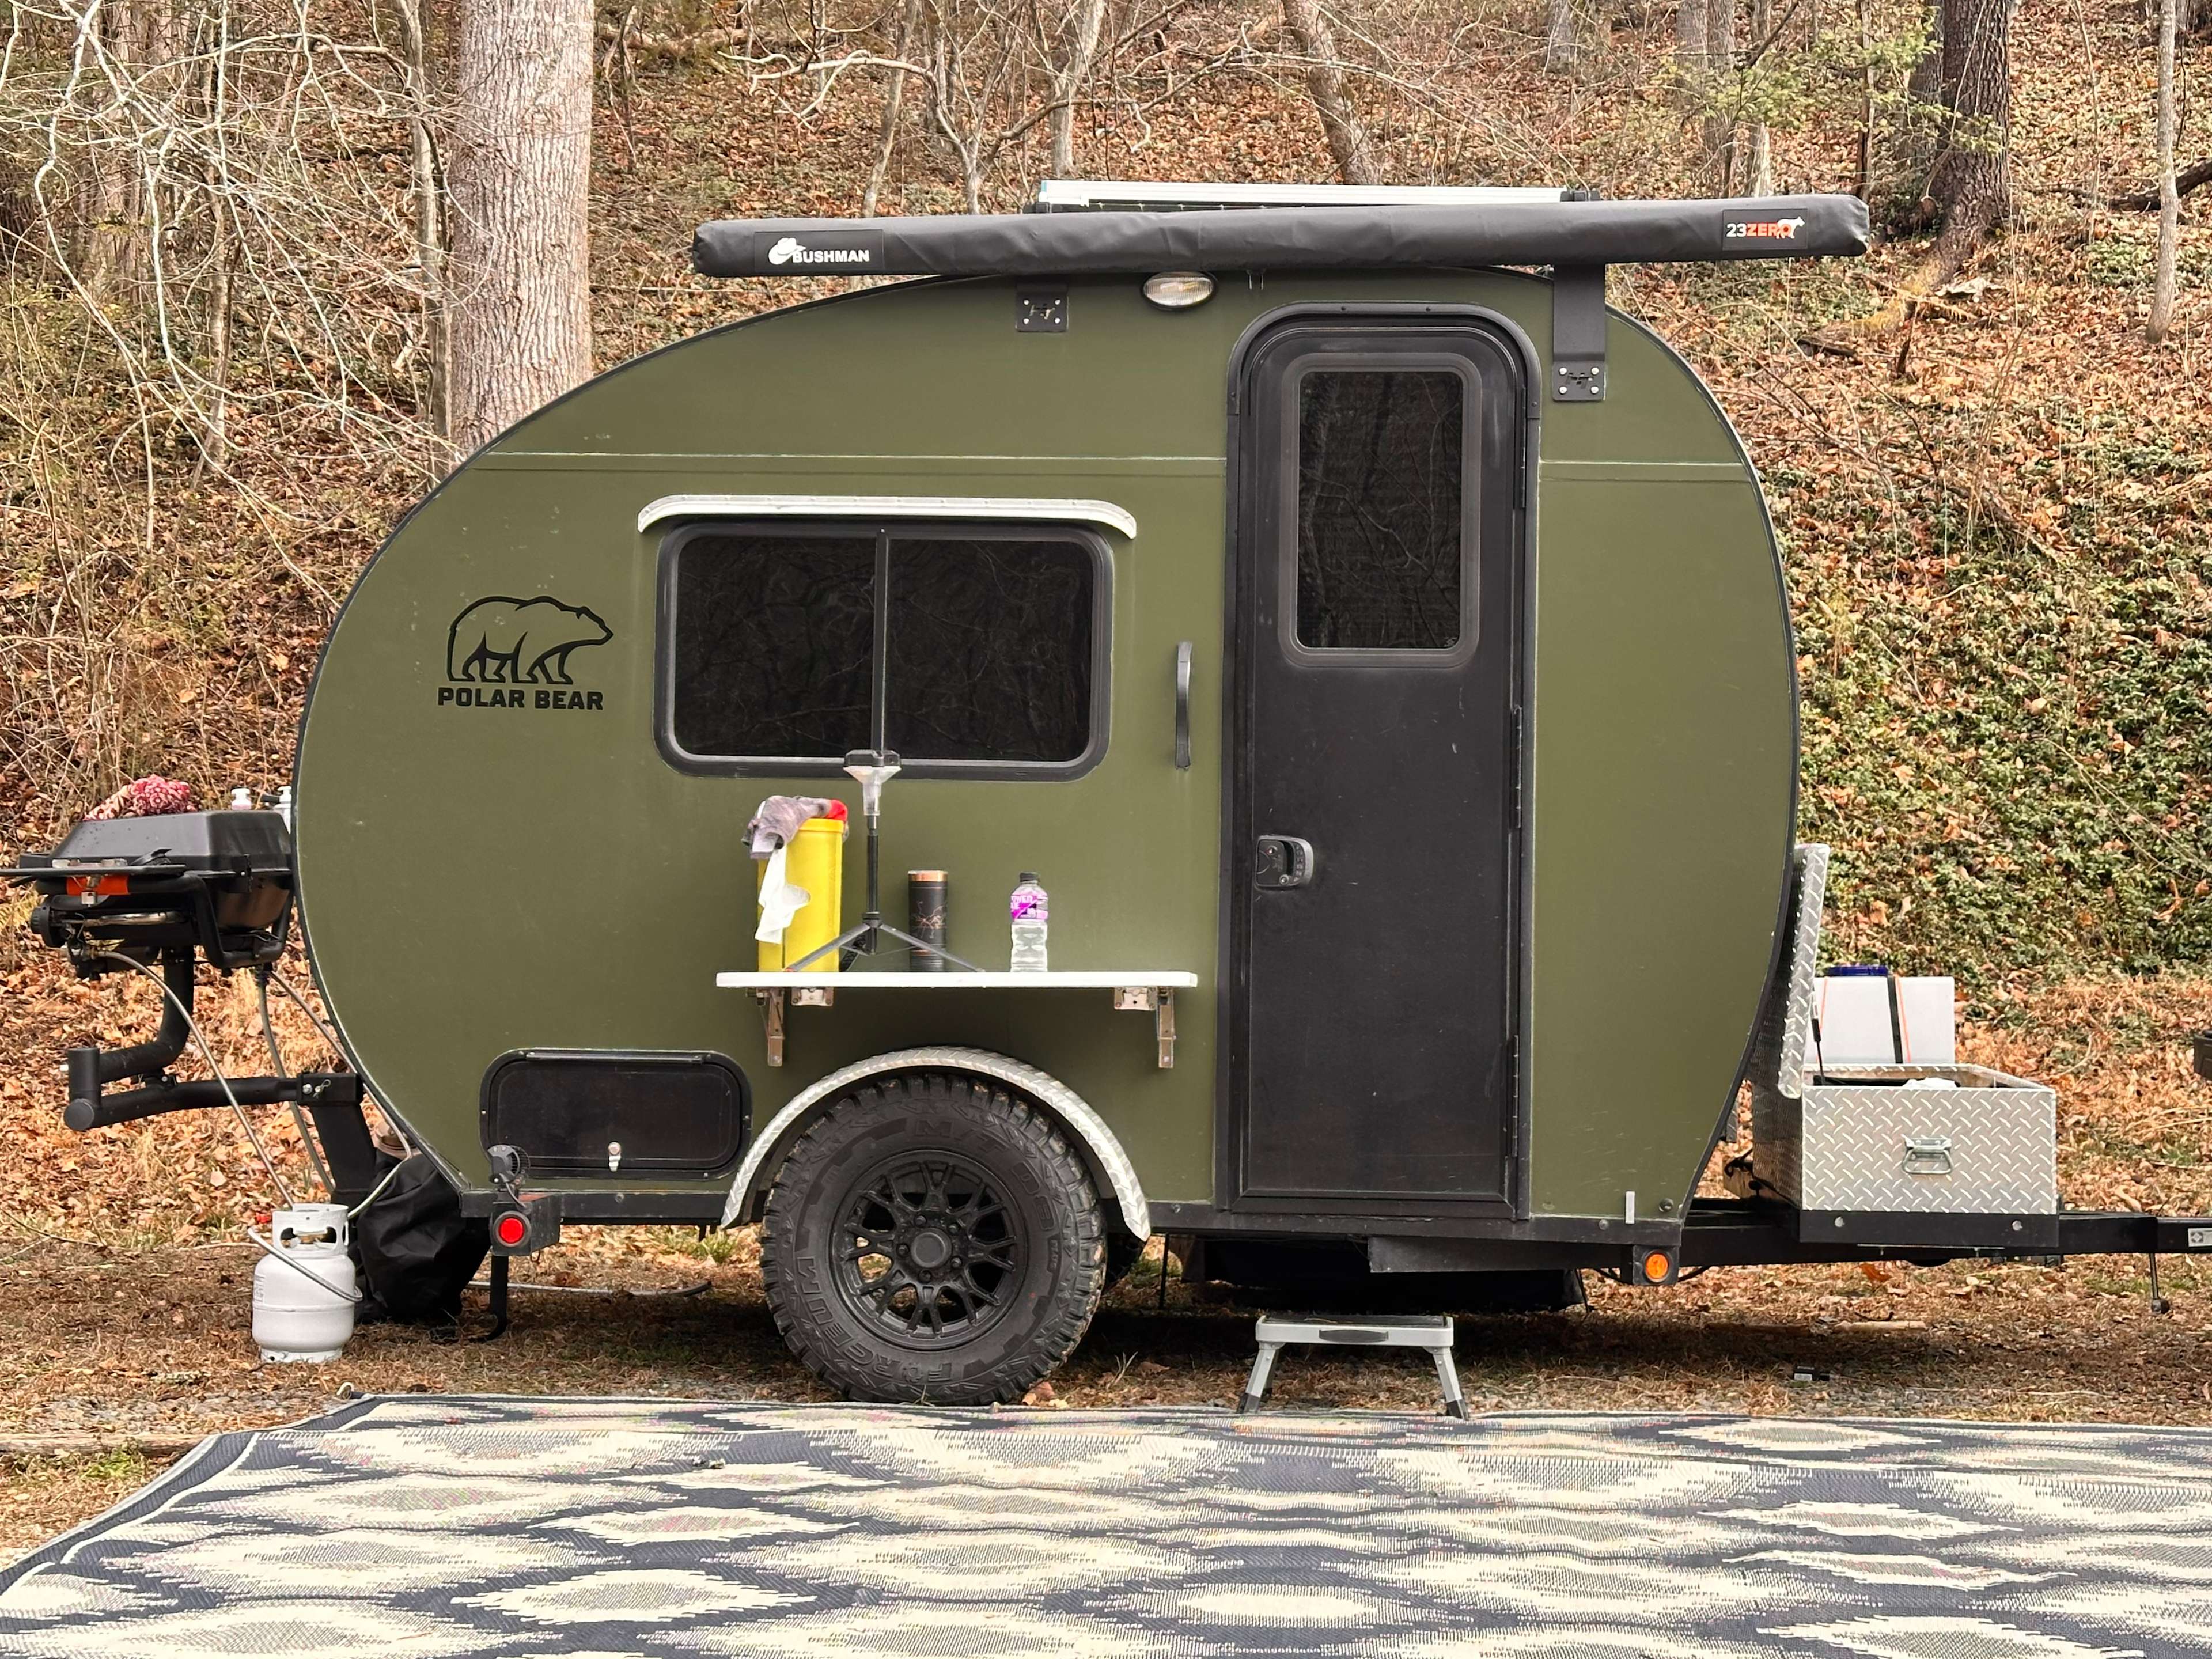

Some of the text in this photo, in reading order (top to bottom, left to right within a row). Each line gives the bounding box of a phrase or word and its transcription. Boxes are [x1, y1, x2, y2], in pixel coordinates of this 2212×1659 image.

[1726, 222, 1792, 237] 23ZERO
[793, 249, 870, 263] BUSHMAN
[438, 687, 603, 710] POLAR BEAR
